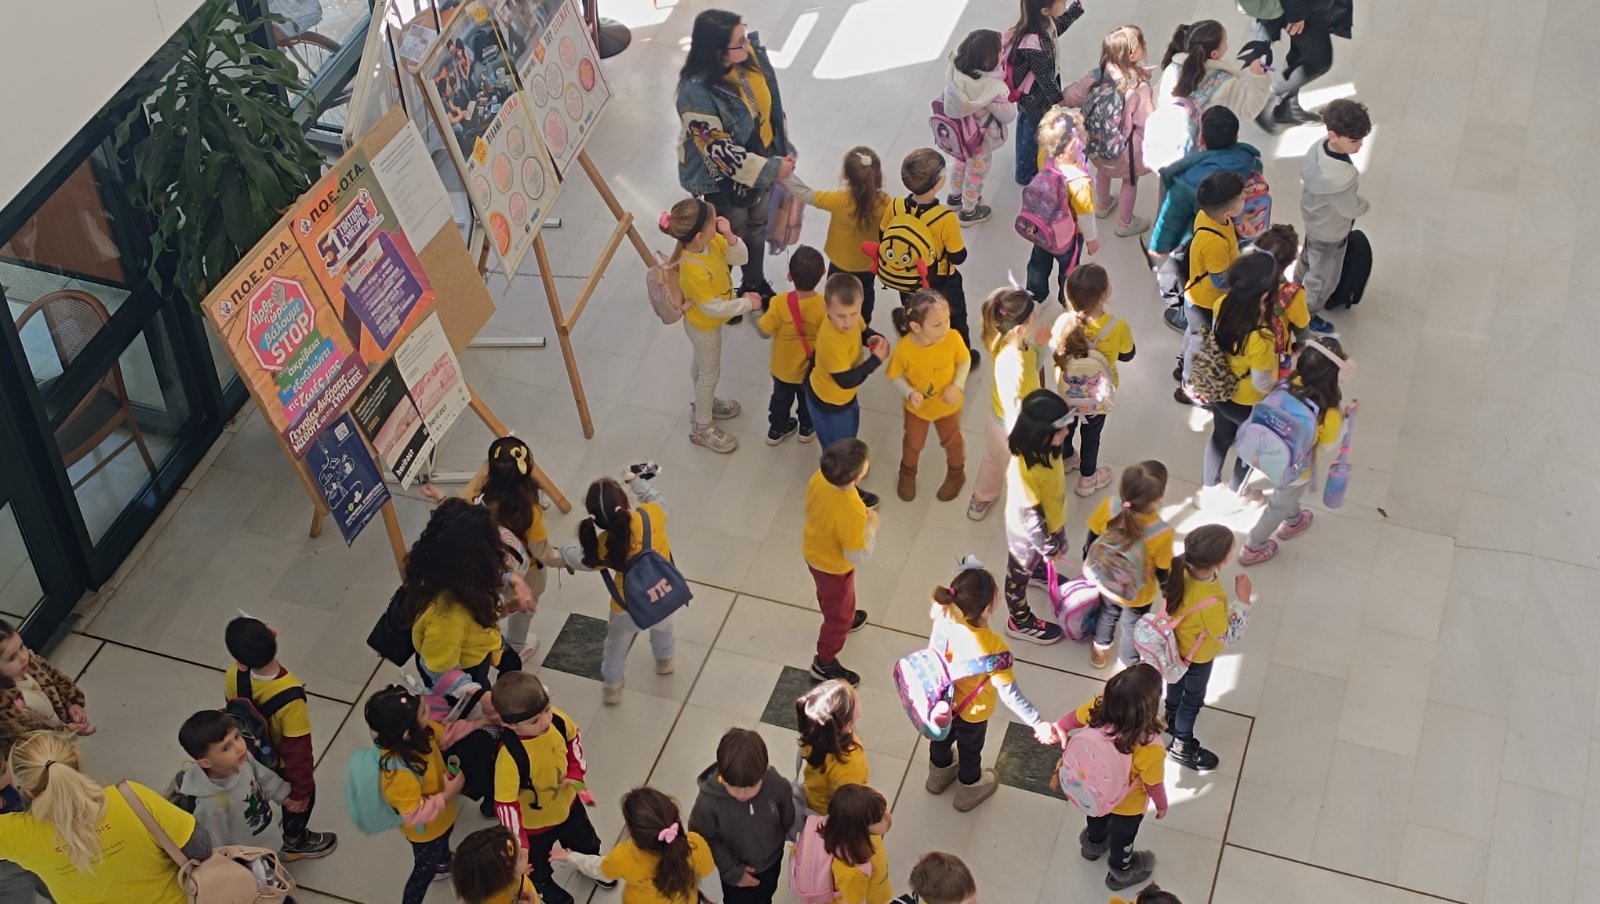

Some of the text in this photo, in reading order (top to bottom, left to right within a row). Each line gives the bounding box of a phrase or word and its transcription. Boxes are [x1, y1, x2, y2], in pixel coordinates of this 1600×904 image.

[230, 241, 292, 305] Π.Ο.Ε.-Ο.Τ.Α.
[252, 298, 274, 325] ήρθε
[264, 302, 302, 349] βάλουμε
[270, 304, 288, 323] ώρα
[271, 312, 309, 364] STOP
[288, 338, 320, 376] ακρίβεια
[288, 359, 342, 412] τις ζωές μας
[292, 347, 331, 393] εξαθλιώνει
[289, 407, 319, 444] Γενναίες
[316, 373, 348, 413] Αυξήσεις
[292, 418, 322, 453] ΜΙΣΘΟΥΣ
[331, 369, 363, 410] ΣΥΝΤΑΞΕΙΣ
